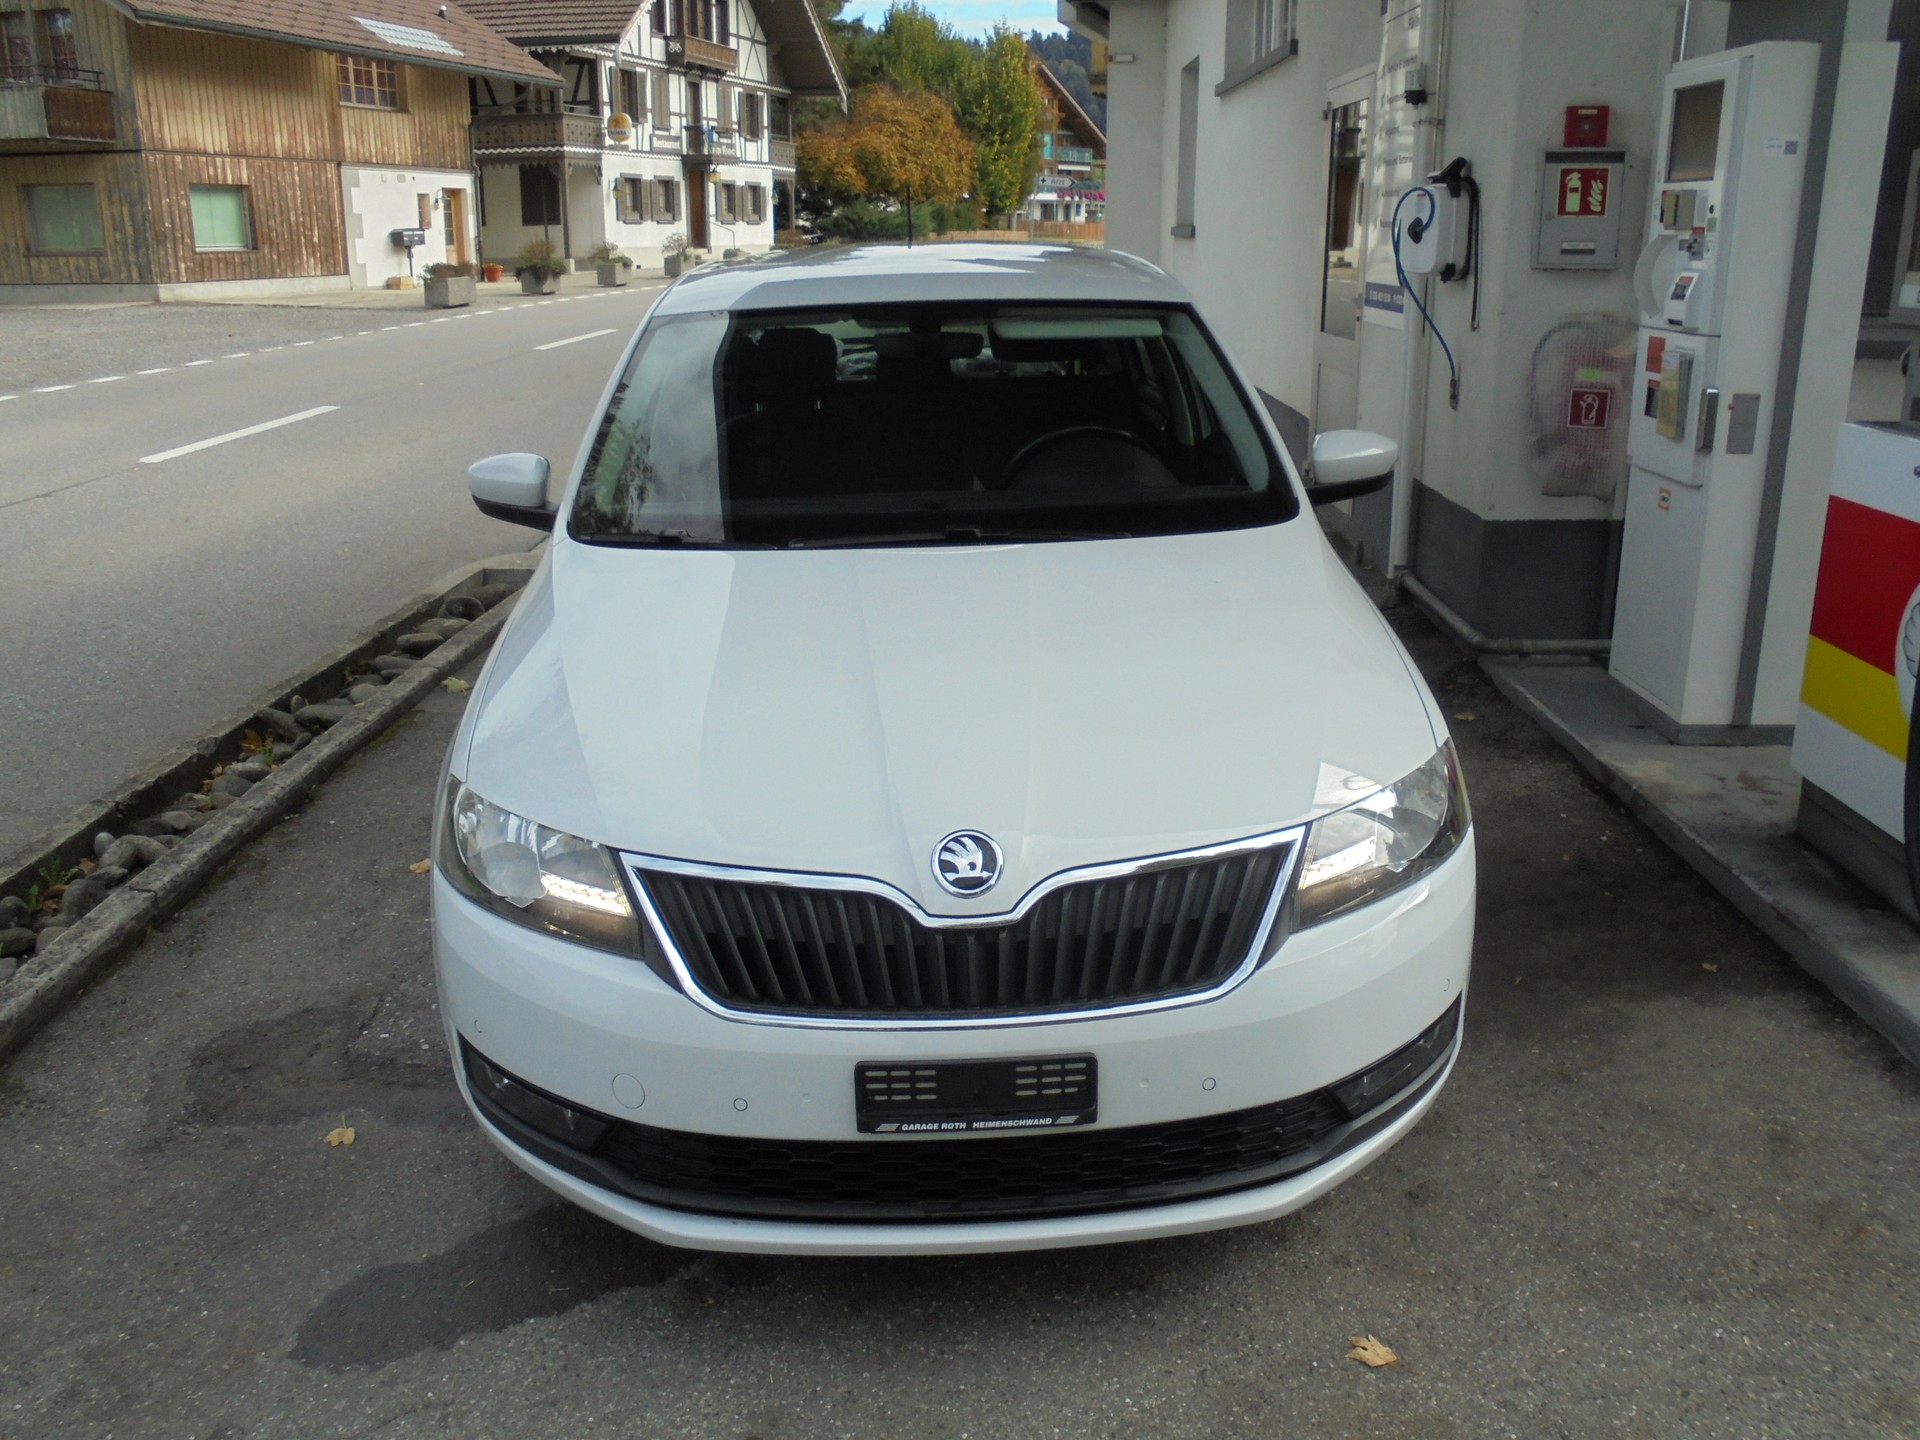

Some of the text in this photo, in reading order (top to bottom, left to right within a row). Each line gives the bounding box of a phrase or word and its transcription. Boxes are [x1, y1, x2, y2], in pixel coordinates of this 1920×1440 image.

[653, 137, 681, 149] Restaurant
[901, 1117, 1053, 1131] GARAGE ROTH HEIMENSCHWAND
